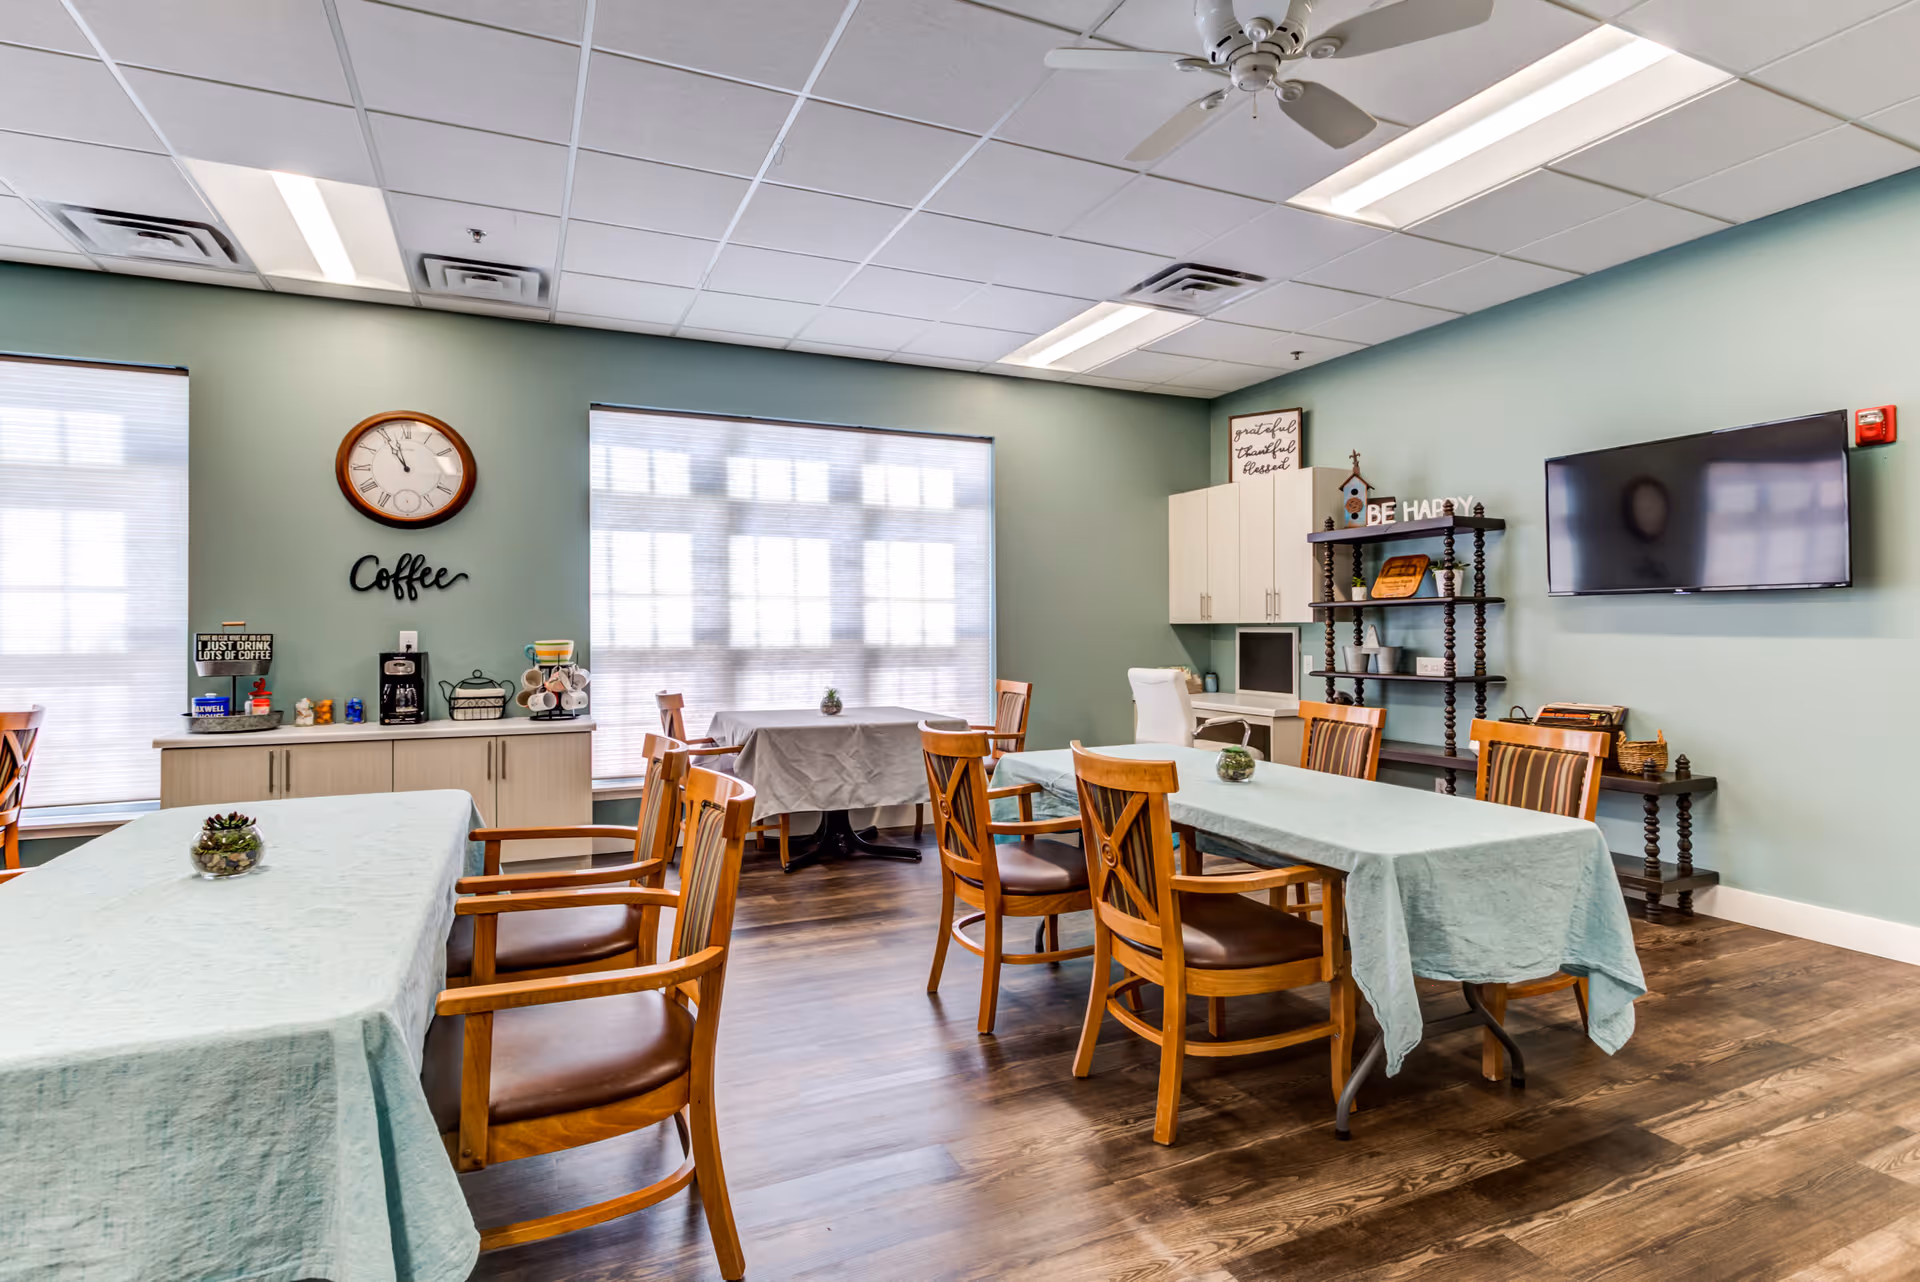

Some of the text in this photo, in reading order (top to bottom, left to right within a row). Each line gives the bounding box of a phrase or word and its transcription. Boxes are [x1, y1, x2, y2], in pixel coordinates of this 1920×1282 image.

[1233, 417, 1297, 442] grateful
[1235, 438, 1297, 460] thankful
[1242, 456, 1291, 475] blessed
[1366, 501, 1397, 527] BE
[349, 553, 469, 601] Coffee
[198, 641, 271, 651] I JUST DRINK
[198, 650, 271, 660] LOTS OF COFFEE
